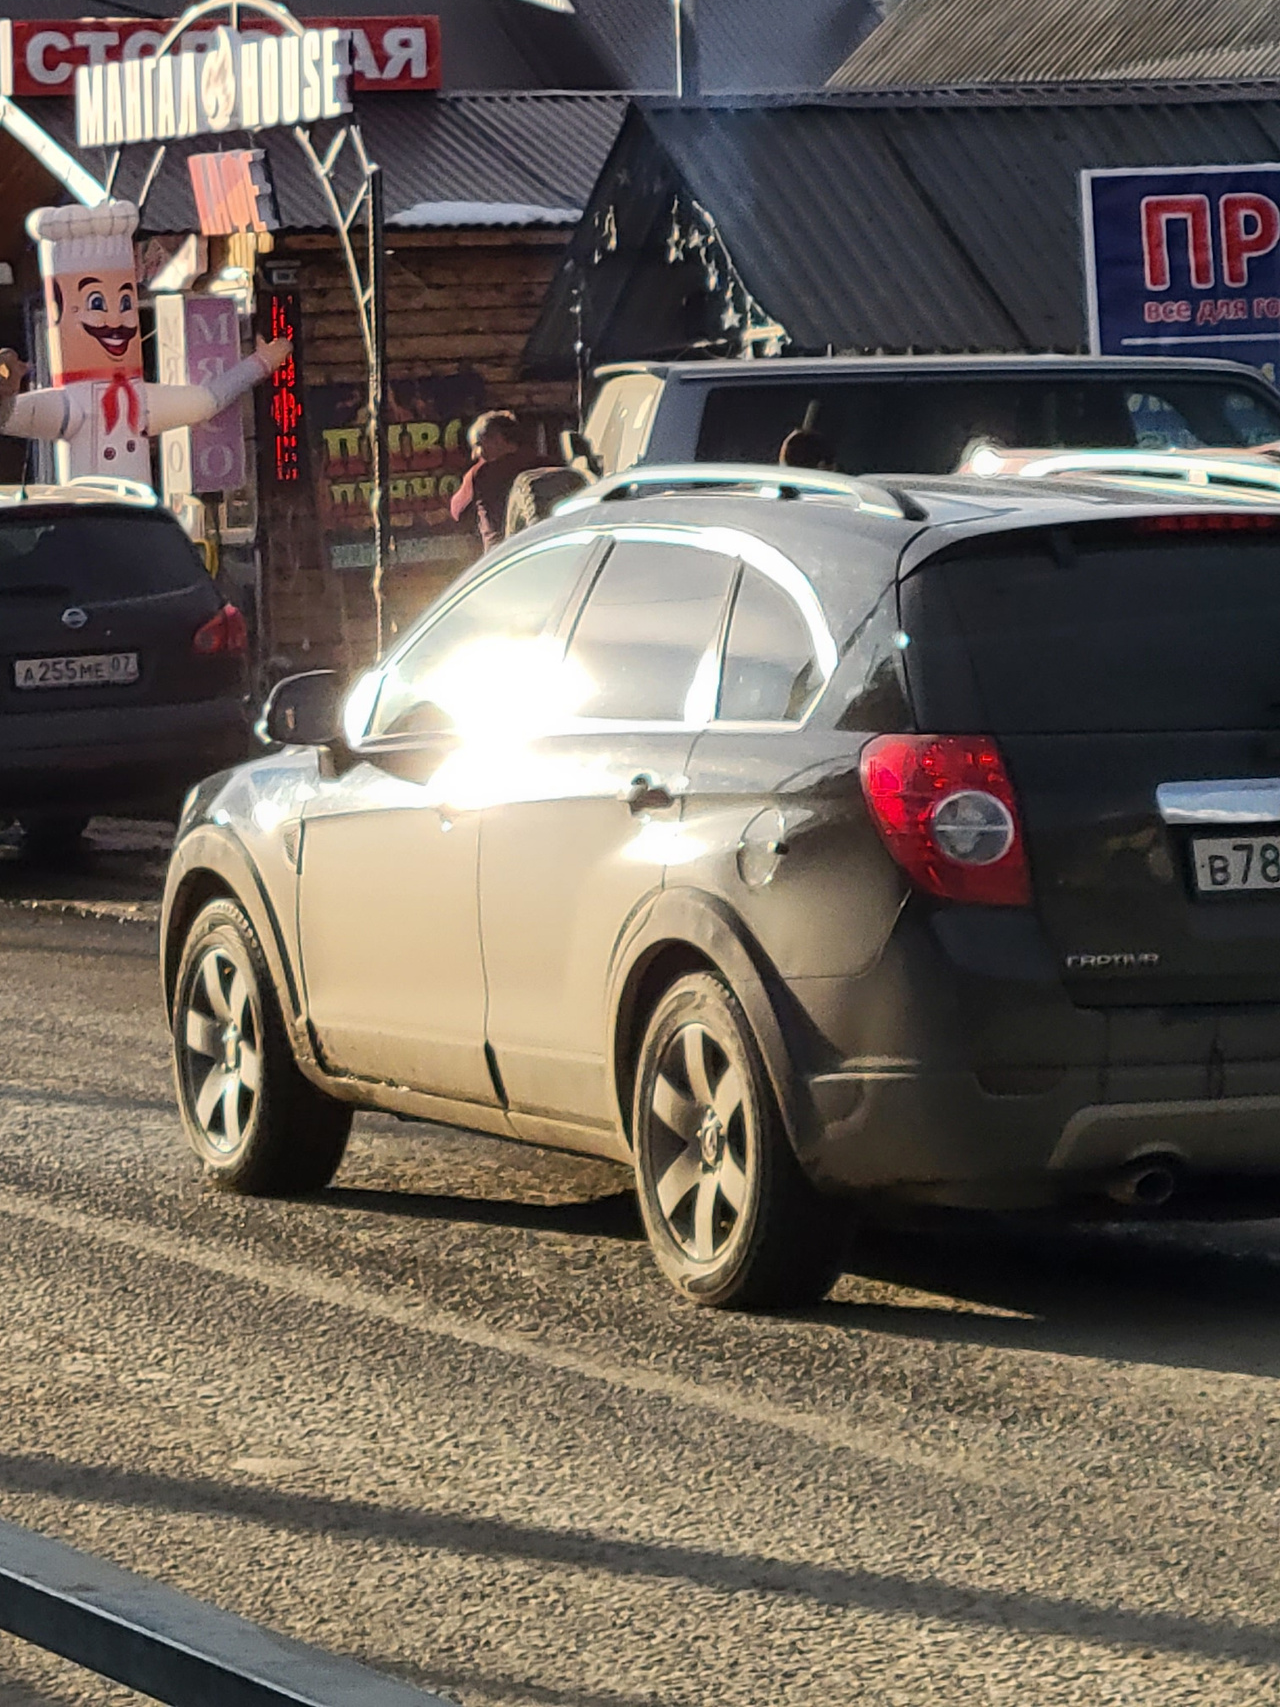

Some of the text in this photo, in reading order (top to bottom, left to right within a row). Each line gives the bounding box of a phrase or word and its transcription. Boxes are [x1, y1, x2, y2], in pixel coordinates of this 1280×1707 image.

[26, 27, 429, 85] СТАЯ
[76, 28, 343, 147] МАНГАЛ HOUSE
[1140, 192, 1280, 292] ПР
[1144, 301, 1192, 323] все
[1195, 298, 1249, 326] для
[191, 312, 236, 478] МЯО
[24, 661, 105, 682] А255МЕ
[1208, 843, 1280, 886] В78
